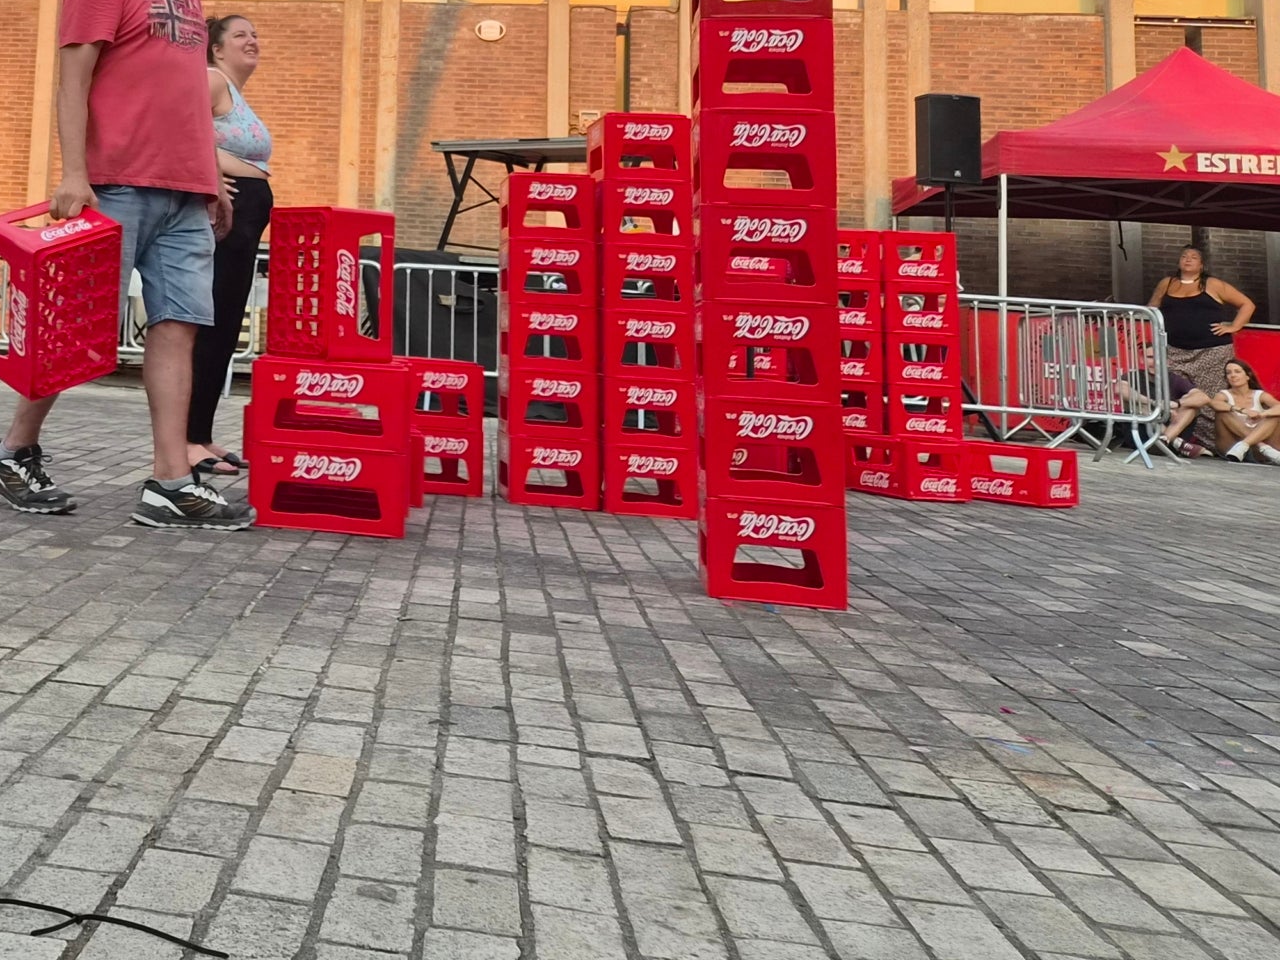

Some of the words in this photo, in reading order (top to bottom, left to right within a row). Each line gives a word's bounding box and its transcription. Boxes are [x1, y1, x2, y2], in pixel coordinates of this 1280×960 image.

[730, 30, 803, 52] Coca-Cola
[624, 124, 673, 140] Coca-Cola
[731, 124, 806, 147] Coca-Cola
[1196, 152, 1280, 176] ESTRE
[529, 183, 576, 200] Coca-Cola
[624, 188, 673, 204] Coca-Cola
[732, 217, 806, 242] Coca-Cola
[531, 249, 579, 265] Coca-Cola
[627, 253, 675, 271] Coca-Cola
[336, 248, 356, 318] Coca-Cola
[530, 313, 577, 330] Coca-Cola
[626, 320, 675, 338] Coca-Cola
[734, 315, 809, 340] Coca-Cola
[294, 373, 363, 397] Coca-Cola
[423, 372, 467, 388] Coca-Cola
[532, 380, 580, 397] Coca-Cola
[627, 388, 677, 405] Coca-Cola
[737, 414, 813, 440] Coca-Cola
[425, 437, 468, 454] Coca-Cola
[532, 448, 581, 466] Coca-Cola
[627, 455, 678, 474] Coca-Cola
[292, 455, 361, 481] Coca-Cola
[738, 513, 814, 541] Coca-Cola
